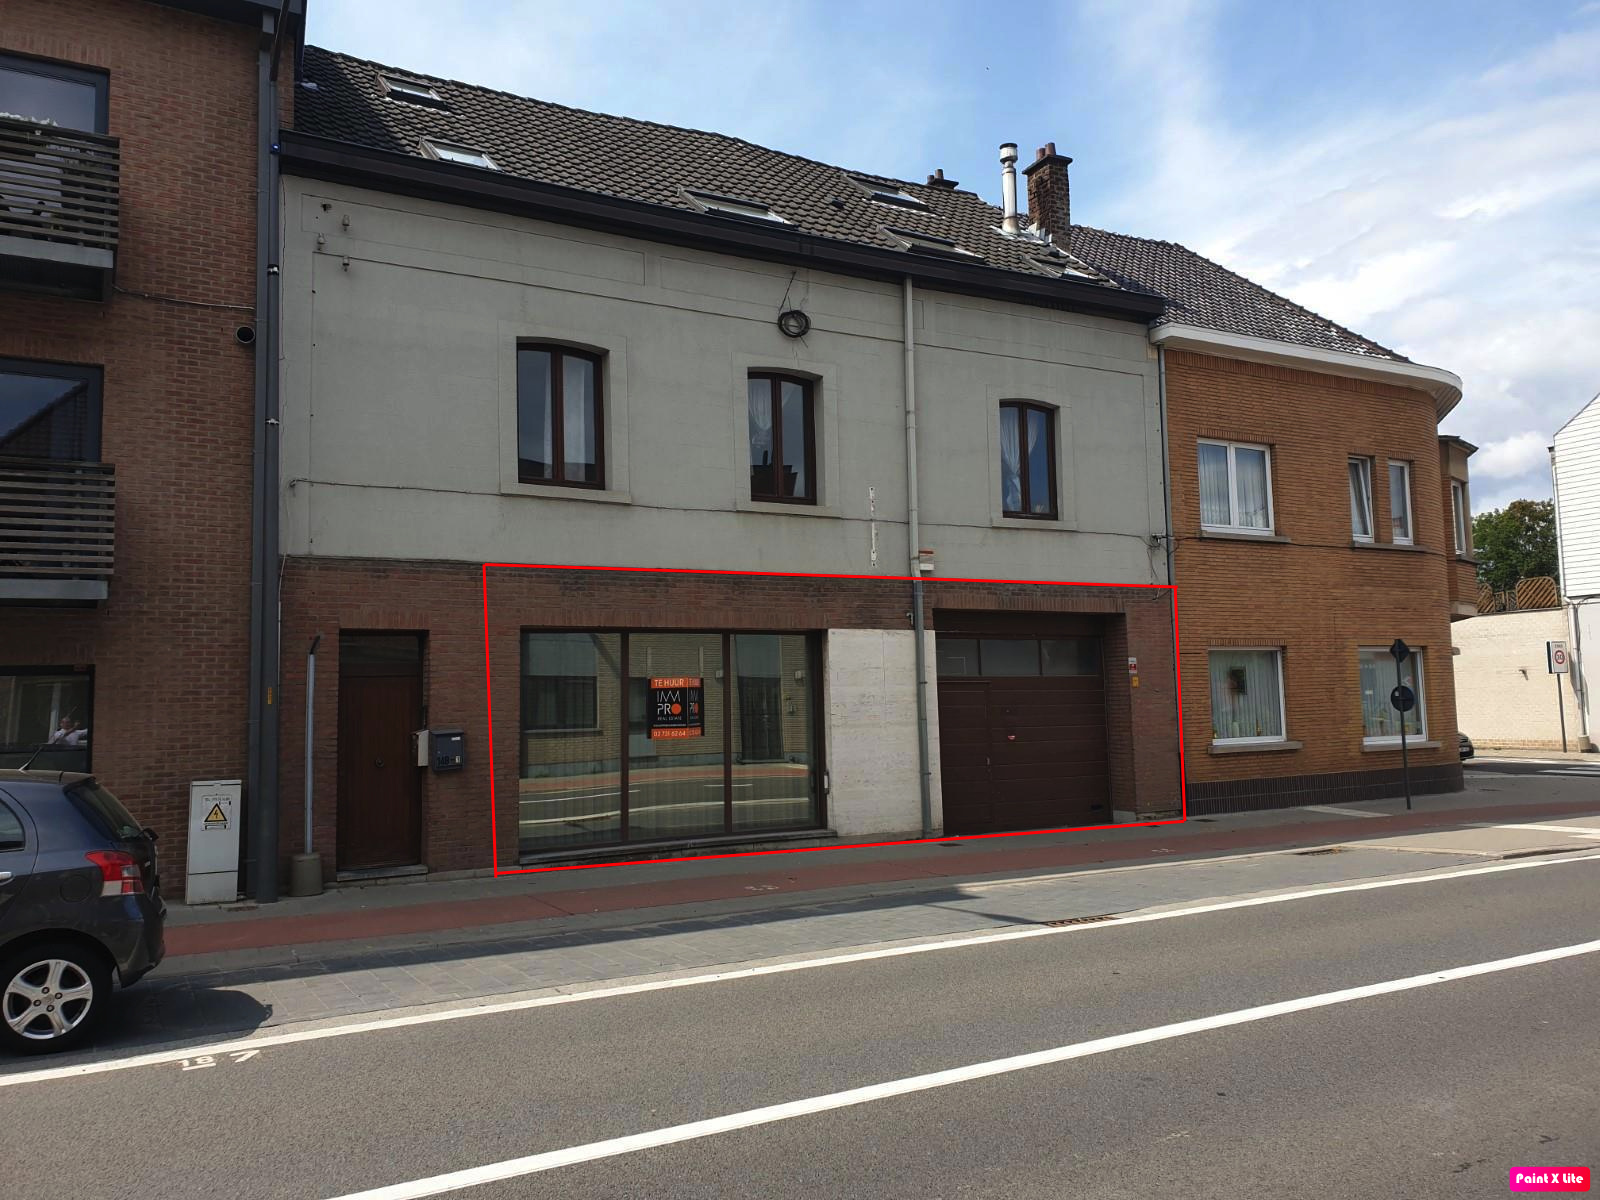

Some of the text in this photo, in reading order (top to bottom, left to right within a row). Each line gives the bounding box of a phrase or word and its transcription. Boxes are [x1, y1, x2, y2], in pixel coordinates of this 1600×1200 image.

[654, 679, 663, 687] TE
[664, 678, 685, 687] HUUR
[656, 690, 681, 702] IMM
